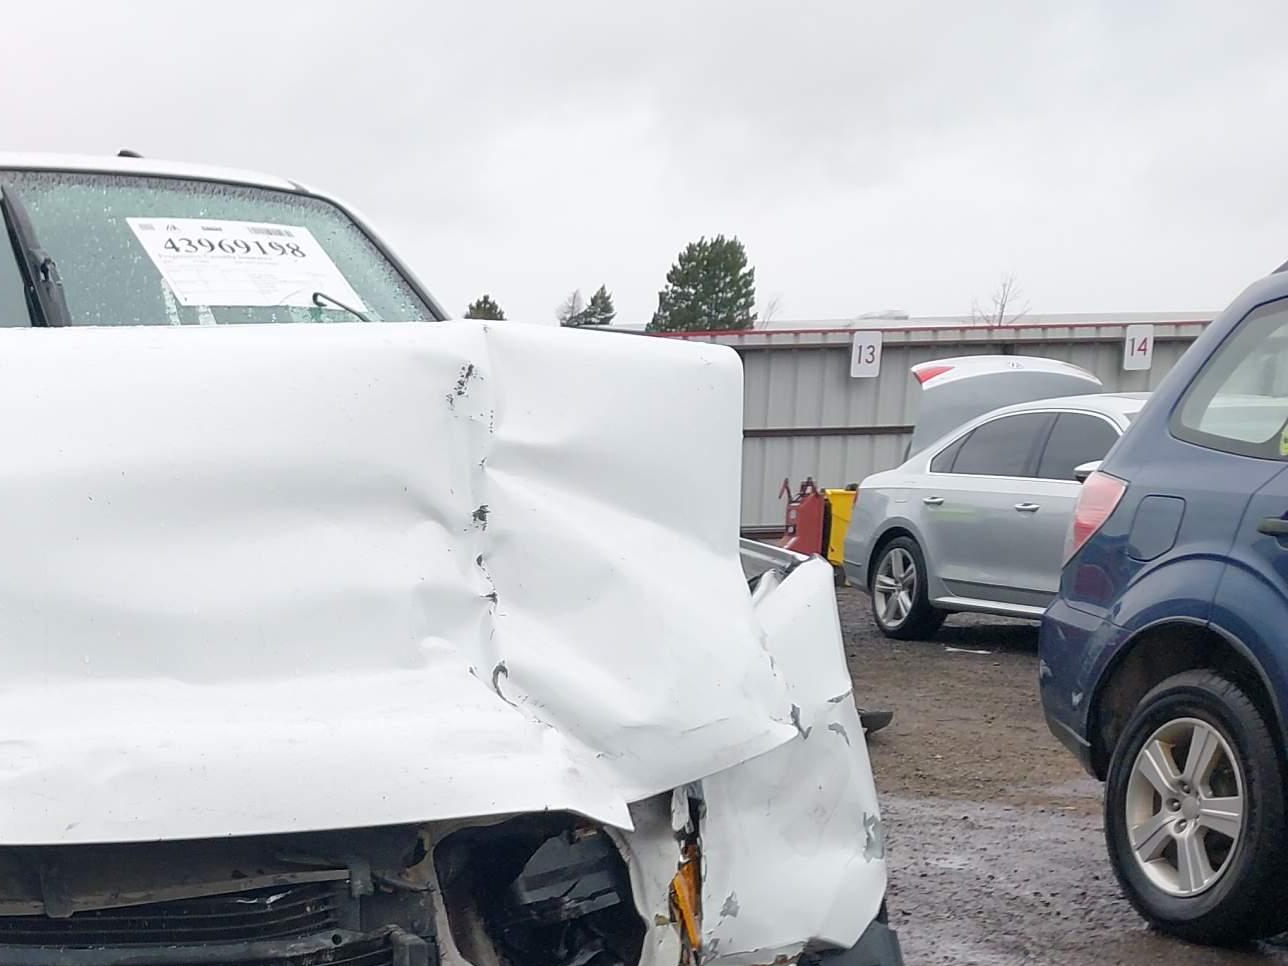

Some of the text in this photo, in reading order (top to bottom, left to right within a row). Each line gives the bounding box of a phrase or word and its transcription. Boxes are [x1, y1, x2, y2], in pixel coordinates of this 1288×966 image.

[164, 237, 306, 258] 43969198
[857, 344, 876, 365] 13
[1128, 336, 1148, 357] 14
